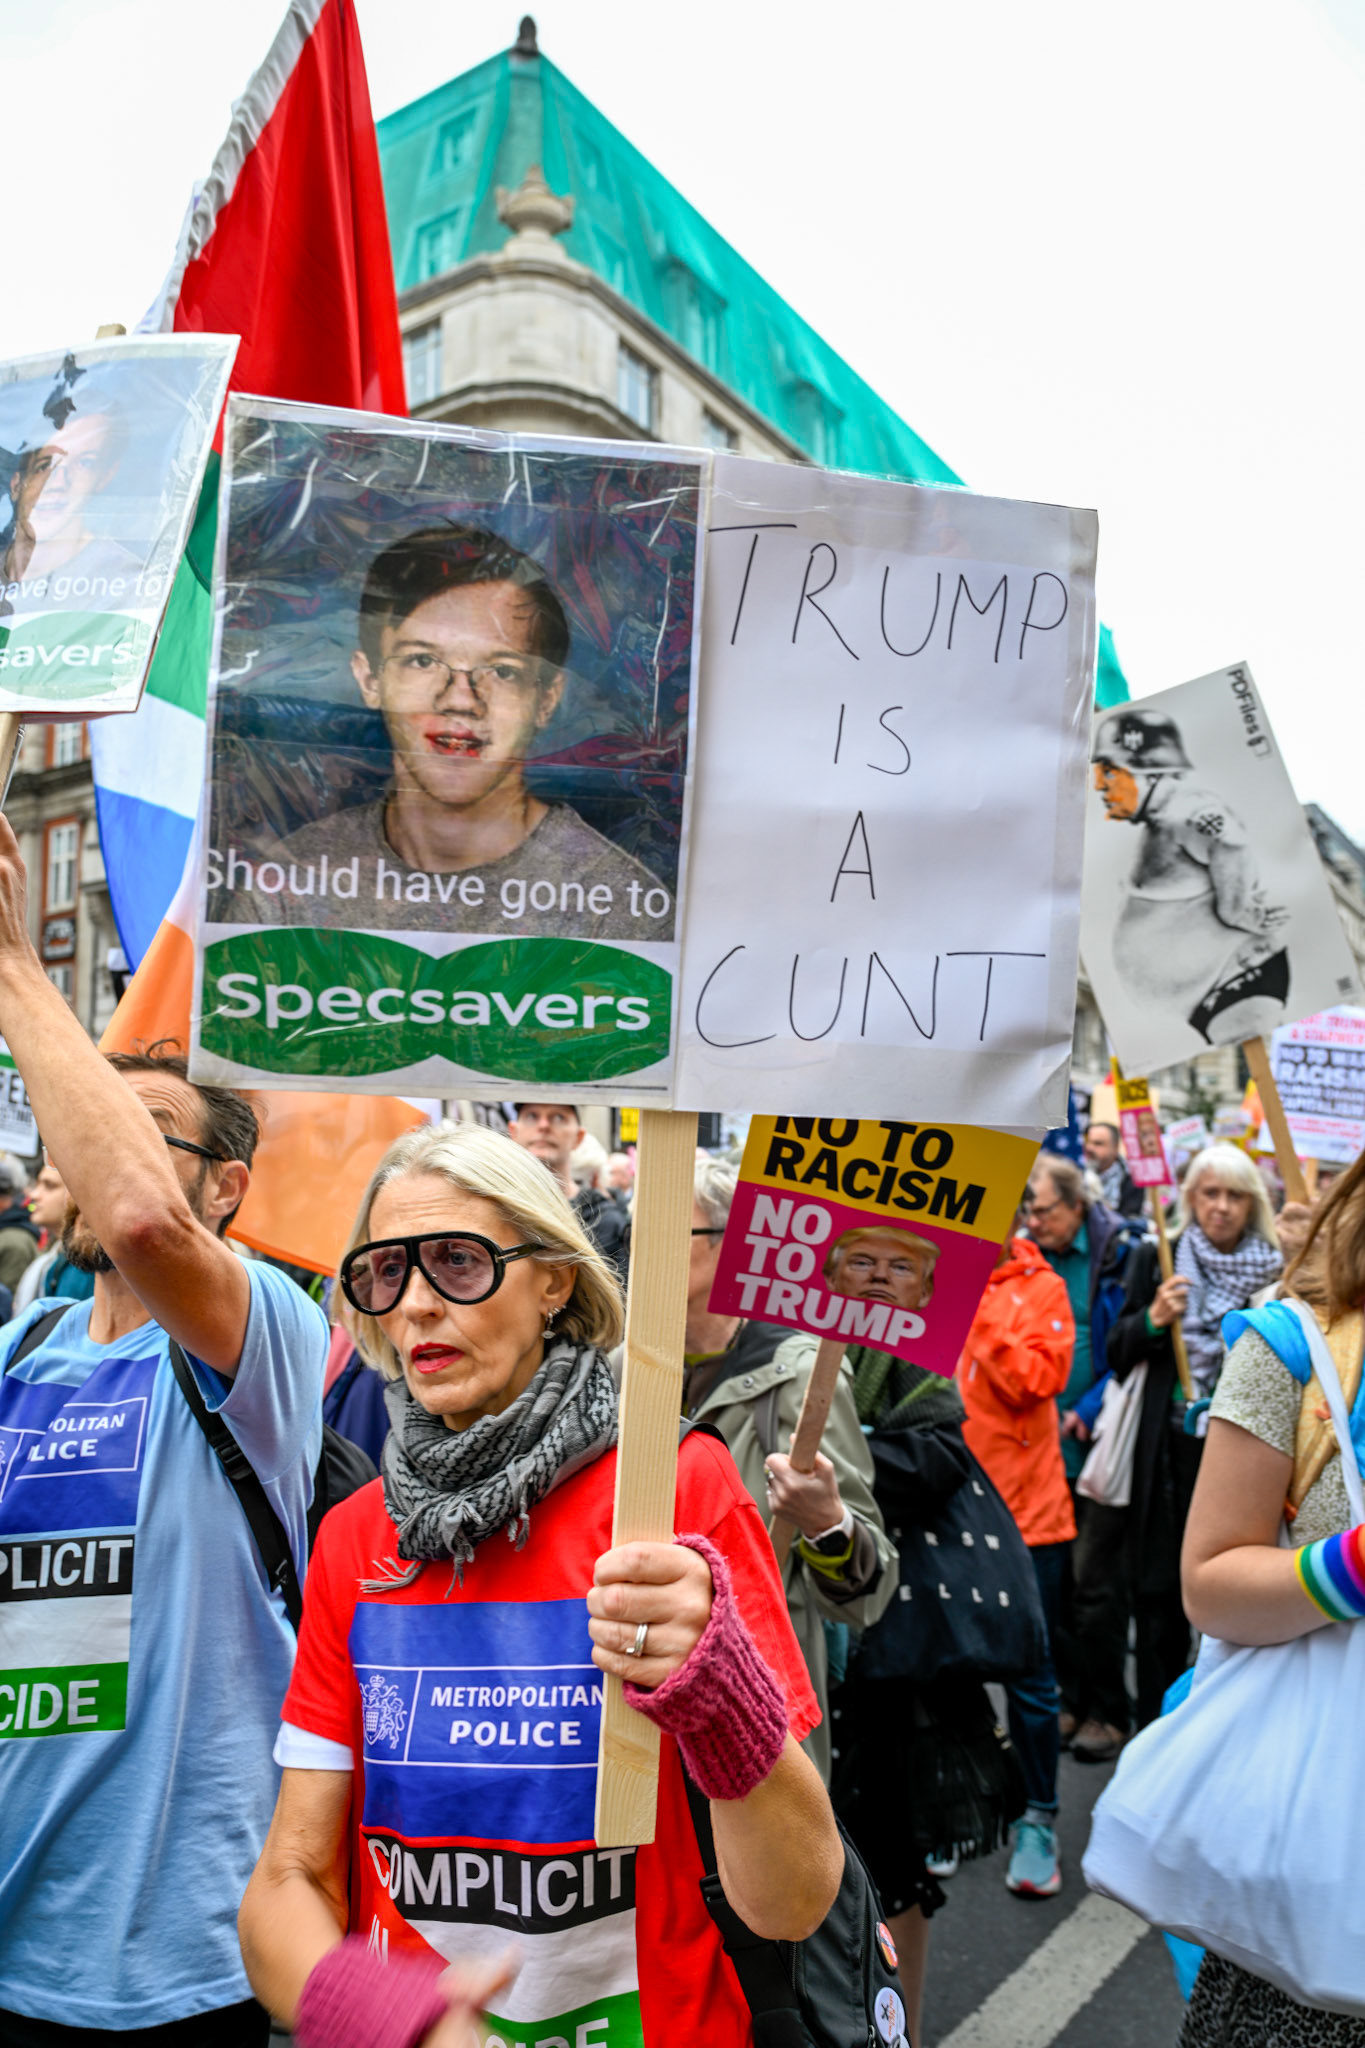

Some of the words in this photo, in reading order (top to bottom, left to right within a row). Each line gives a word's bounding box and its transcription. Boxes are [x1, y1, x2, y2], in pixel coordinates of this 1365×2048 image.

[53, 575, 126, 601] gone
[134, 573, 163, 597] to
[708, 523, 1069, 664] TRUMP
[833, 703, 911, 776] IS
[206, 848, 360, 899] Should
[377, 858, 486, 907] have
[501, 877, 613, 919] gone
[626, 879, 671, 918] to
[830, 810, 876, 903] A
[216, 972, 651, 1031] Specsavers
[695, 945, 1047, 1048] CUNT
[773, 1115, 859, 1148] NO
[878, 1119, 954, 1171] TO
[763, 1135, 987, 1226] RACISM
[748, 1193, 833, 1245] NO
[744, 1233, 816, 1282] TO
[735, 1272, 926, 1347] TRUMP
[430, 1685, 604, 1707] METROPOLITAN
[449, 1720, 582, 1747] POLICE
[367, 1838, 637, 1917] COMPLICIT
